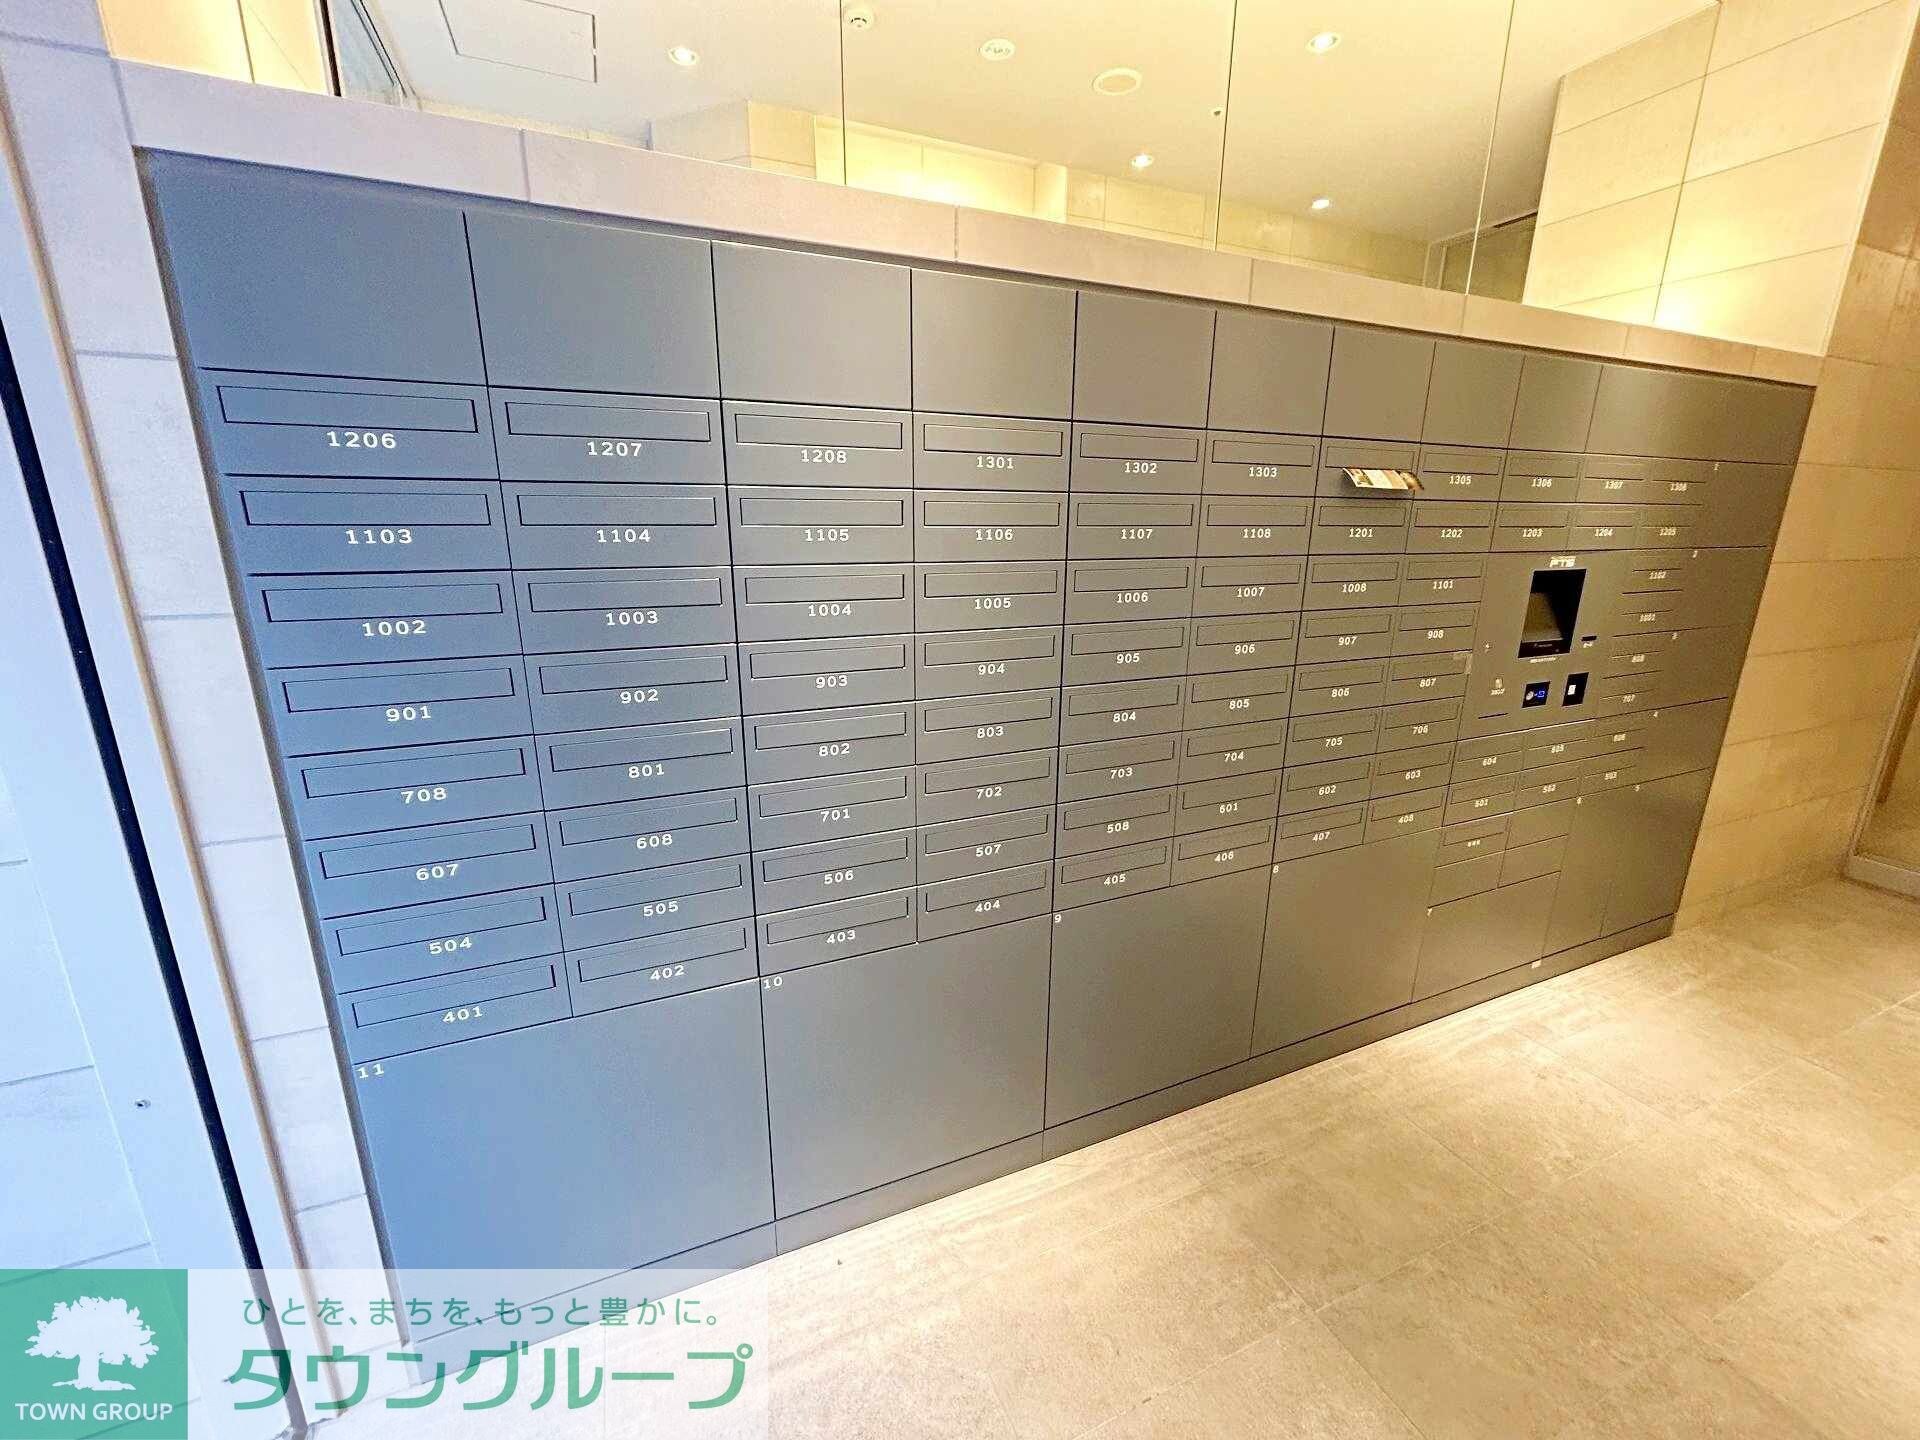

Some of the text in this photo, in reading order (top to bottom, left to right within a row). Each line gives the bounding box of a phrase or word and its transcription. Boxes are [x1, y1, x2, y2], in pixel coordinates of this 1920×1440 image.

[327, 431, 397, 449] 1206
[587, 441, 642, 457] 1207
[800, 450, 847, 463] 1208
[977, 457, 1014, 469] 1301
[1124, 463, 1157, 474] 1302
[1249, 467, 1277, 478] 1303
[1450, 475, 1471, 485] 1305
[346, 529, 413, 544] 1103
[597, 529, 650, 543] 1104
[805, 529, 849, 541] 1105
[976, 529, 1013, 540] 1106
[1121, 529, 1153, 539] 1107
[1243, 529, 1271, 538] 1108
[1349, 528, 1373, 538] 1201
[1441, 529, 1462, 539] 1202
[1523, 528, 1543, 538] 1203
[1342, 583, 1366, 593] 1008
[1433, 580, 1453, 590] 1101
[1116, 592, 1148, 603] 1006
[1237, 587, 1265, 598] 1007
[974, 598, 1011, 609] 1005
[808, 605, 851, 616] 1004
[606, 611, 658, 626] 1003
[362, 621, 426, 637] 1002
[1428, 630, 1443, 639] 908
[1339, 636, 1357, 646] 907
[1234, 644, 1255, 654] 906
[1116, 653, 1140, 664] 905
[978, 664, 1005, 675] 904
[816, 676, 848, 689] 903
[1419, 678, 1436, 688] 807
[620, 689, 658, 703] 902
[1331, 688, 1349, 697] 806
[1229, 699, 1250, 709] 805
[386, 706, 431, 721] 901
[1113, 712, 1136, 723] 804
[977, 726, 1004, 738] 803
[1325, 738, 1342, 747] 705
[819, 744, 850, 756] 802
[1224, 752, 1244, 762] 704
[628, 764, 665, 778] 801
[1110, 768, 1133, 779] 703
[1405, 770, 1421, 780] 603
[401, 788, 446, 803] 708
[977, 787, 1002, 799] 702
[1318, 785, 1336, 795] 602
[1219, 802, 1239, 813] 601
[821, 809, 850, 822] 701
[1398, 814, 1414, 823] 408
[1107, 822, 1129, 833] 508
[636, 834, 673, 849] 608
[1312, 832, 1330, 841] 407
[976, 845, 1001, 857] 507
[1214, 852, 1234, 862] 406
[416, 864, 459, 881] 607
[824, 871, 853, 884] 506
[1104, 874, 1126, 885] 405
[643, 901, 679, 917] 505
[975, 900, 1000, 912] 404
[827, 930, 856, 944] 403
[429, 937, 472, 954] 504
[650, 965, 684, 981] 402
[763, 976, 783, 989] 10
[443, 1007, 483, 1024] 401
[358, 1065, 385, 1078] 11
